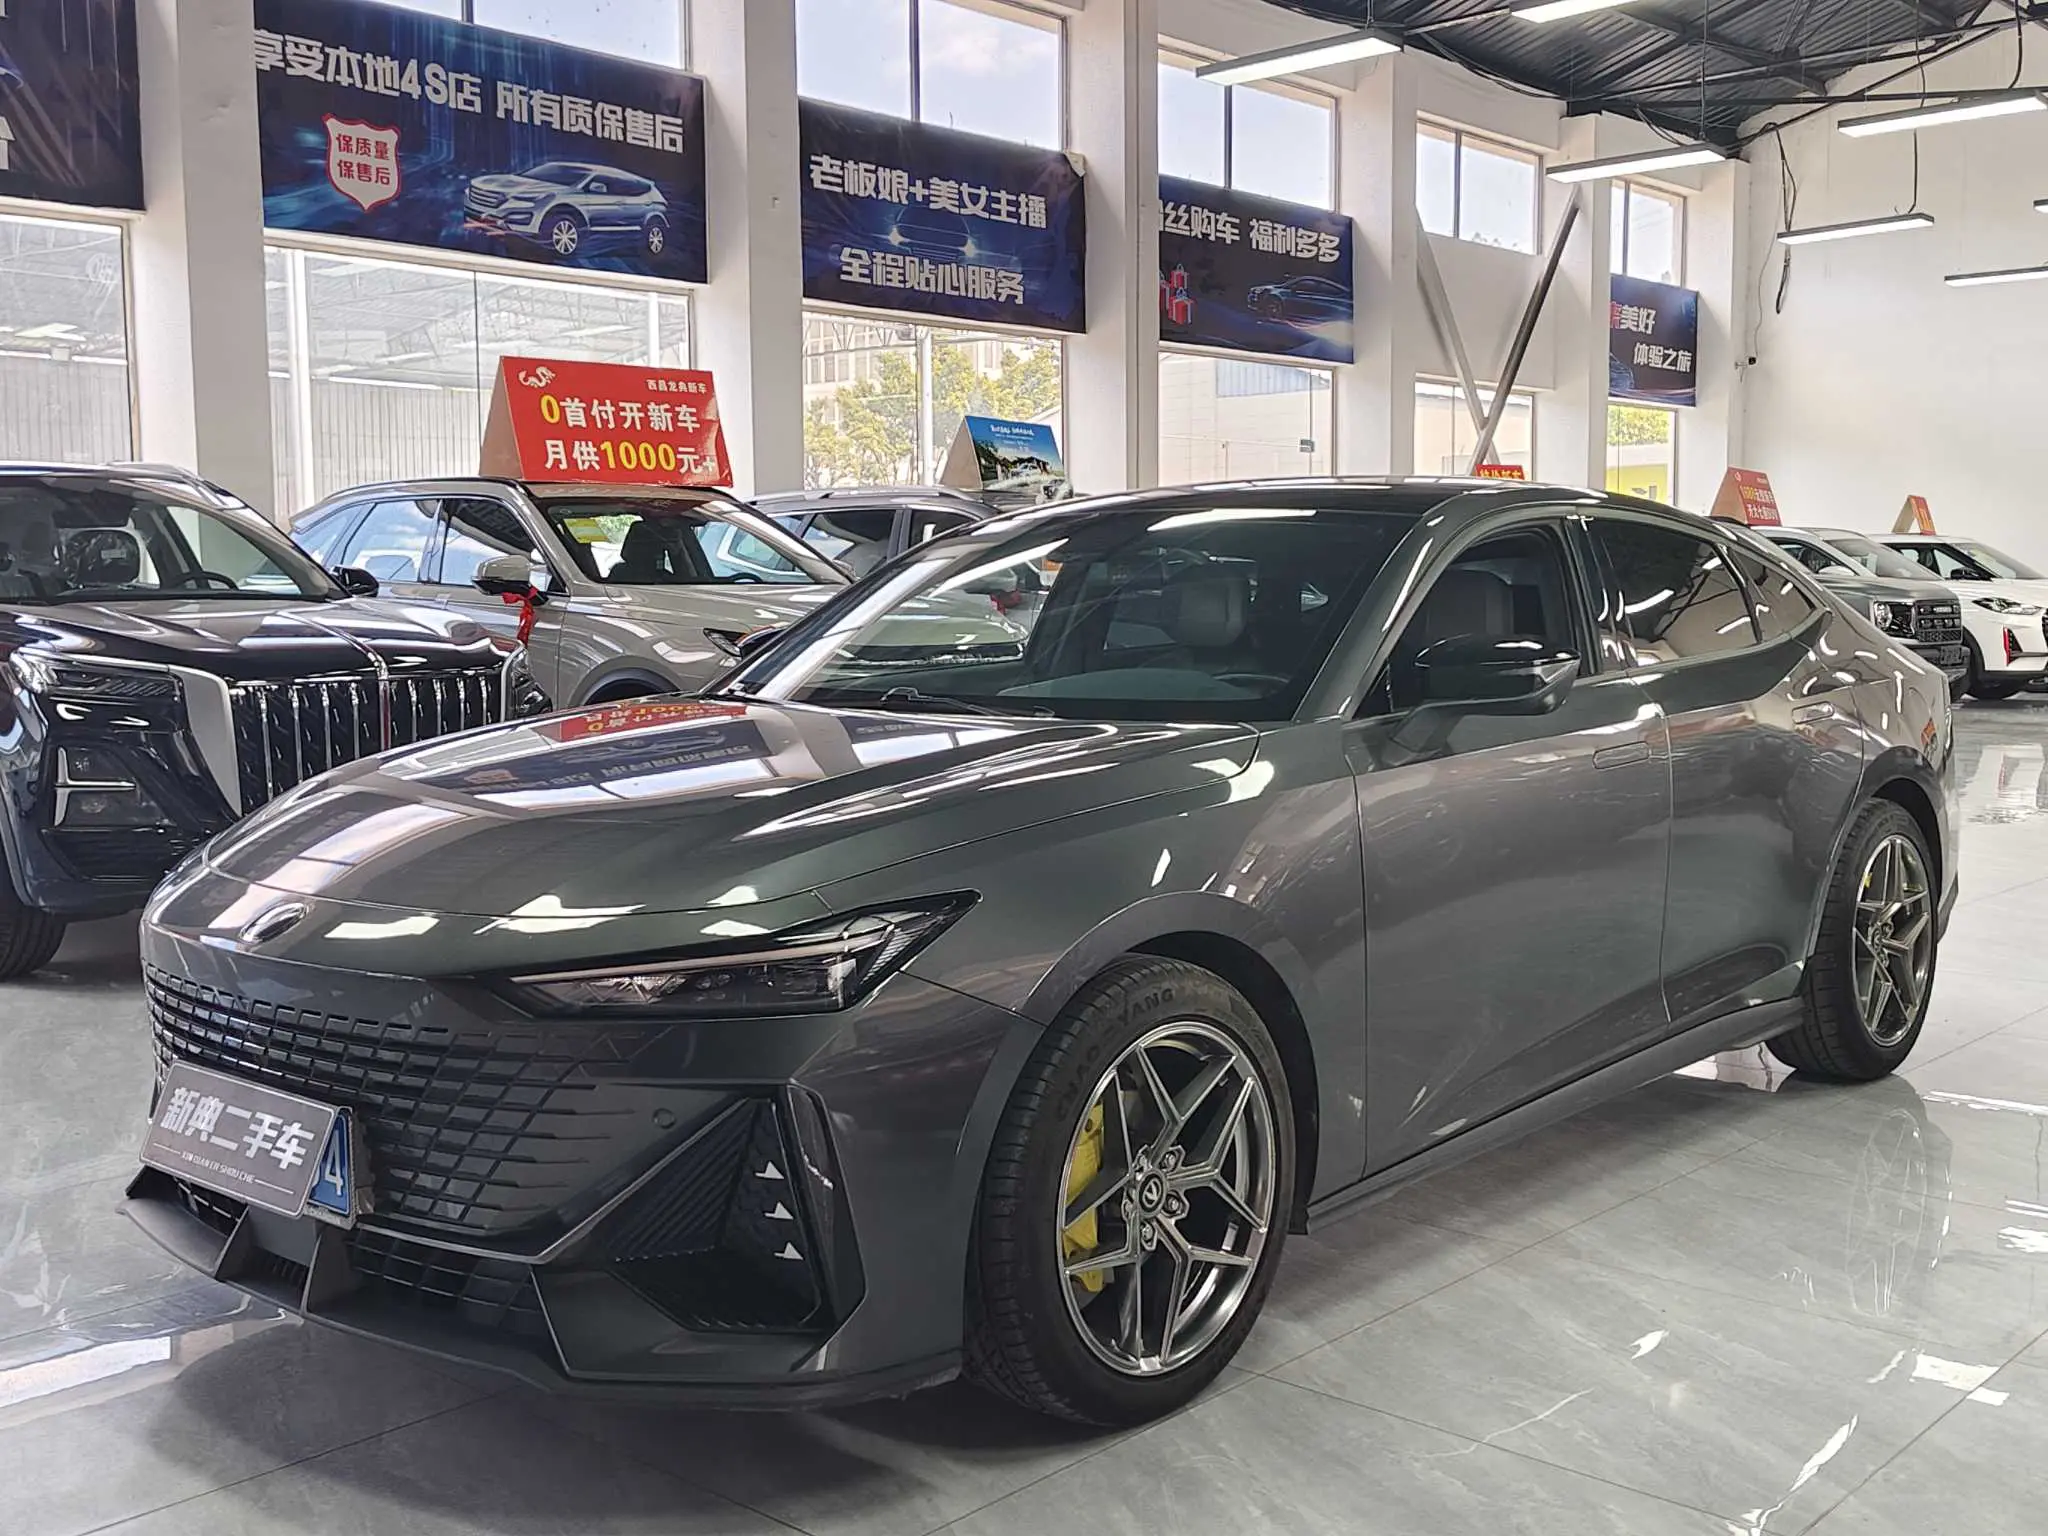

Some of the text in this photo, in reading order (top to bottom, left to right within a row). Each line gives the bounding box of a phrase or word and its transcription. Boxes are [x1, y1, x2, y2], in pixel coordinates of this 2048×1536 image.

[496, 80, 684, 153] 所有质保售后
[336, 133, 389, 160] 保质量
[337, 159, 390, 185] 保售后
[809, 154, 1047, 229] 老板娘+美女主播
[1250, 218, 1340, 263] 福利多多
[839, 247, 1024, 305] 全程贴心服务
[1633, 342, 1692, 372] 体验之旅
[540, 394, 700, 433] 0首付开新车
[160, 1086, 315, 1170] 新典二手车
